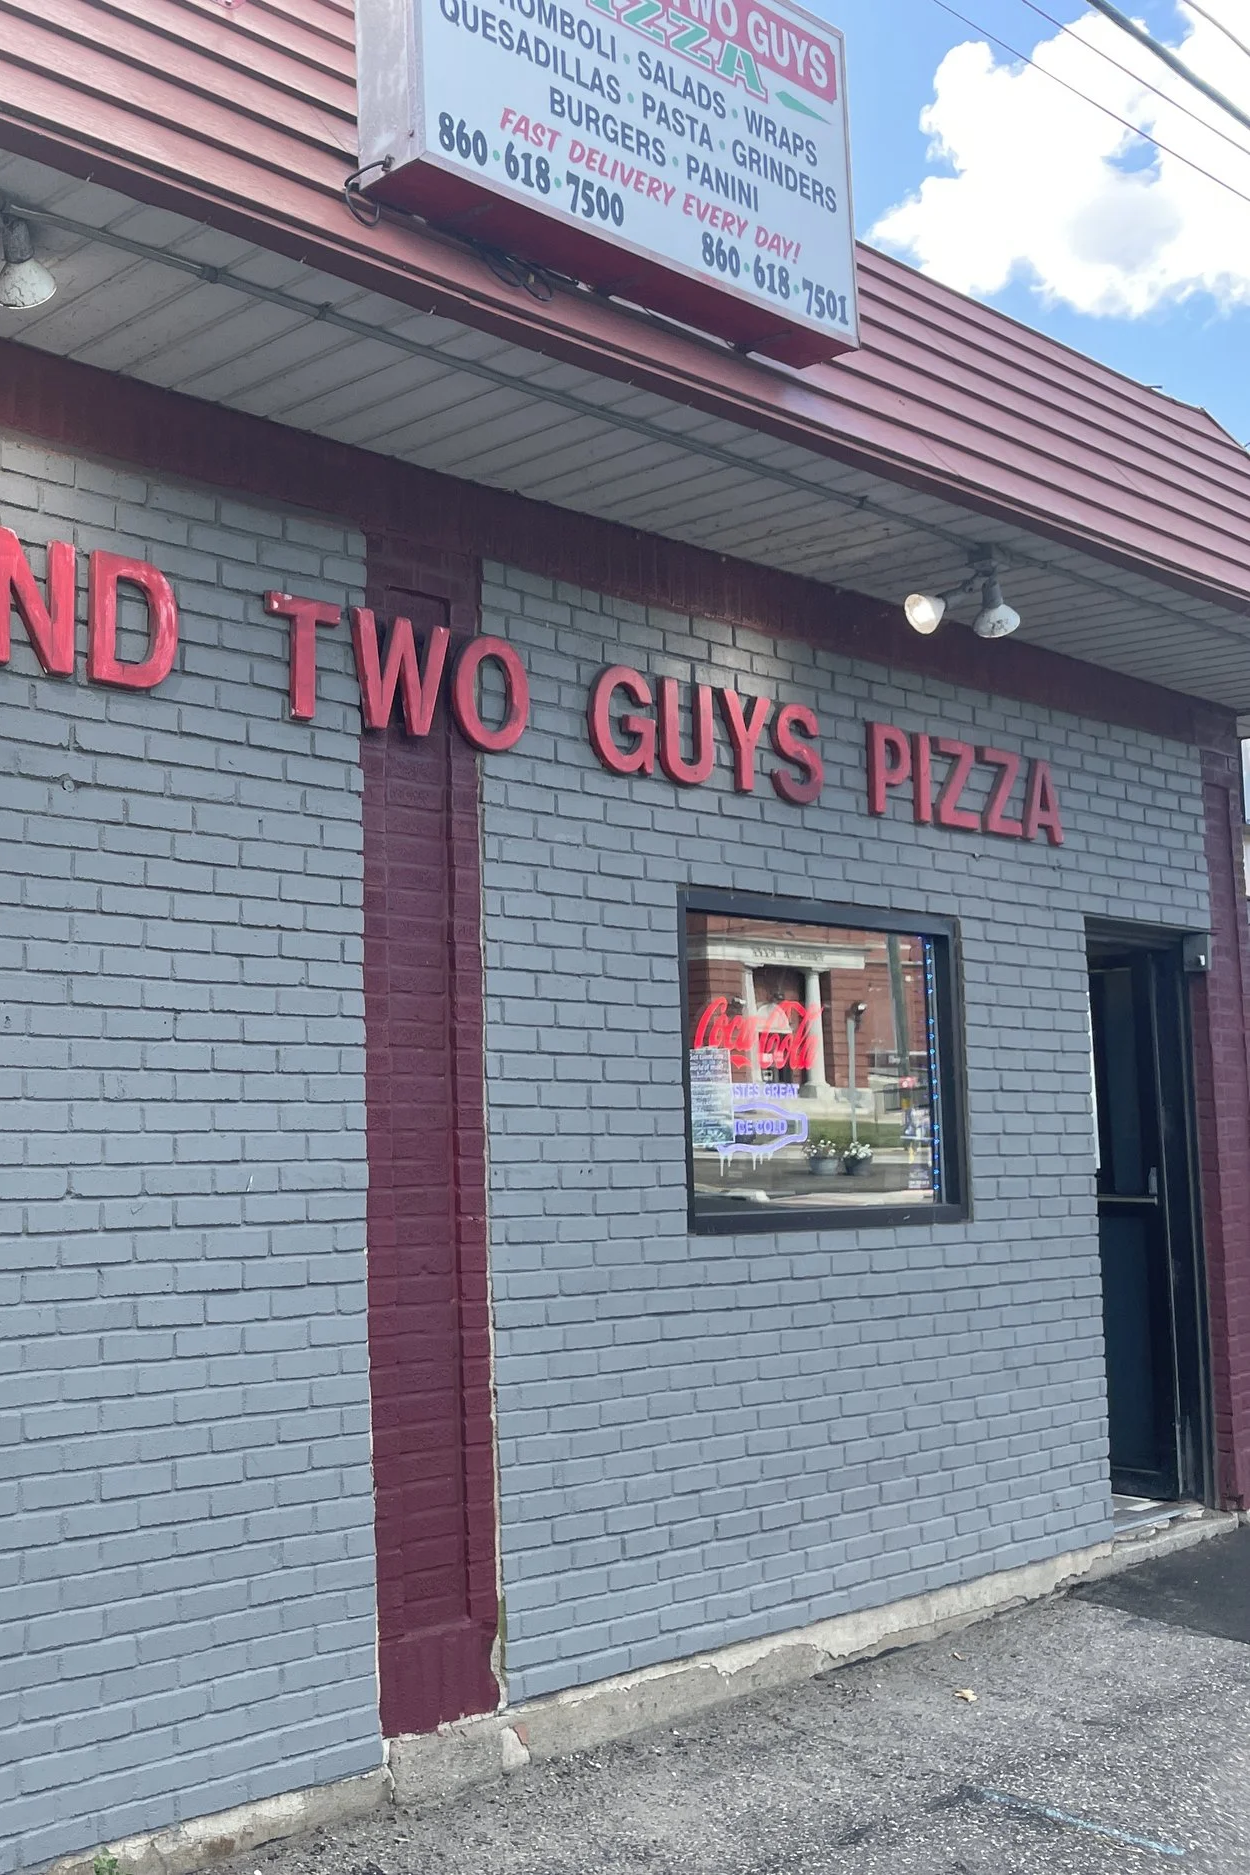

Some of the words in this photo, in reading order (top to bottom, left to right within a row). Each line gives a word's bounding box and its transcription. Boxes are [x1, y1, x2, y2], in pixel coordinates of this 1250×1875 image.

[672, 0, 738, 38] WO
[747, 11, 829, 89] GUYS
[440, 0, 621, 104] QUESADILLAS
[642, 91, 714, 152] PASTA
[732, 139, 837, 213] GRINDERS
[550, 86, 666, 167] BURGERS
[686, 153, 759, 212] PANINI
[638, 51, 726, 119] SALADS
[744, 105, 817, 166] WRAPS
[500, 107, 562, 152] FAST
[568, 139, 676, 206] DELIVERY
[682, 193, 749, 239] EVERY
[754, 225, 802, 264] DAY!
[263, 589, 530, 752] TWO
[587, 663, 826, 805] GUYS
[865, 720, 1064, 847] PIZZA
[755, 1119, 788, 1135] COLD
[763, 1083, 800, 1098] GREAT
